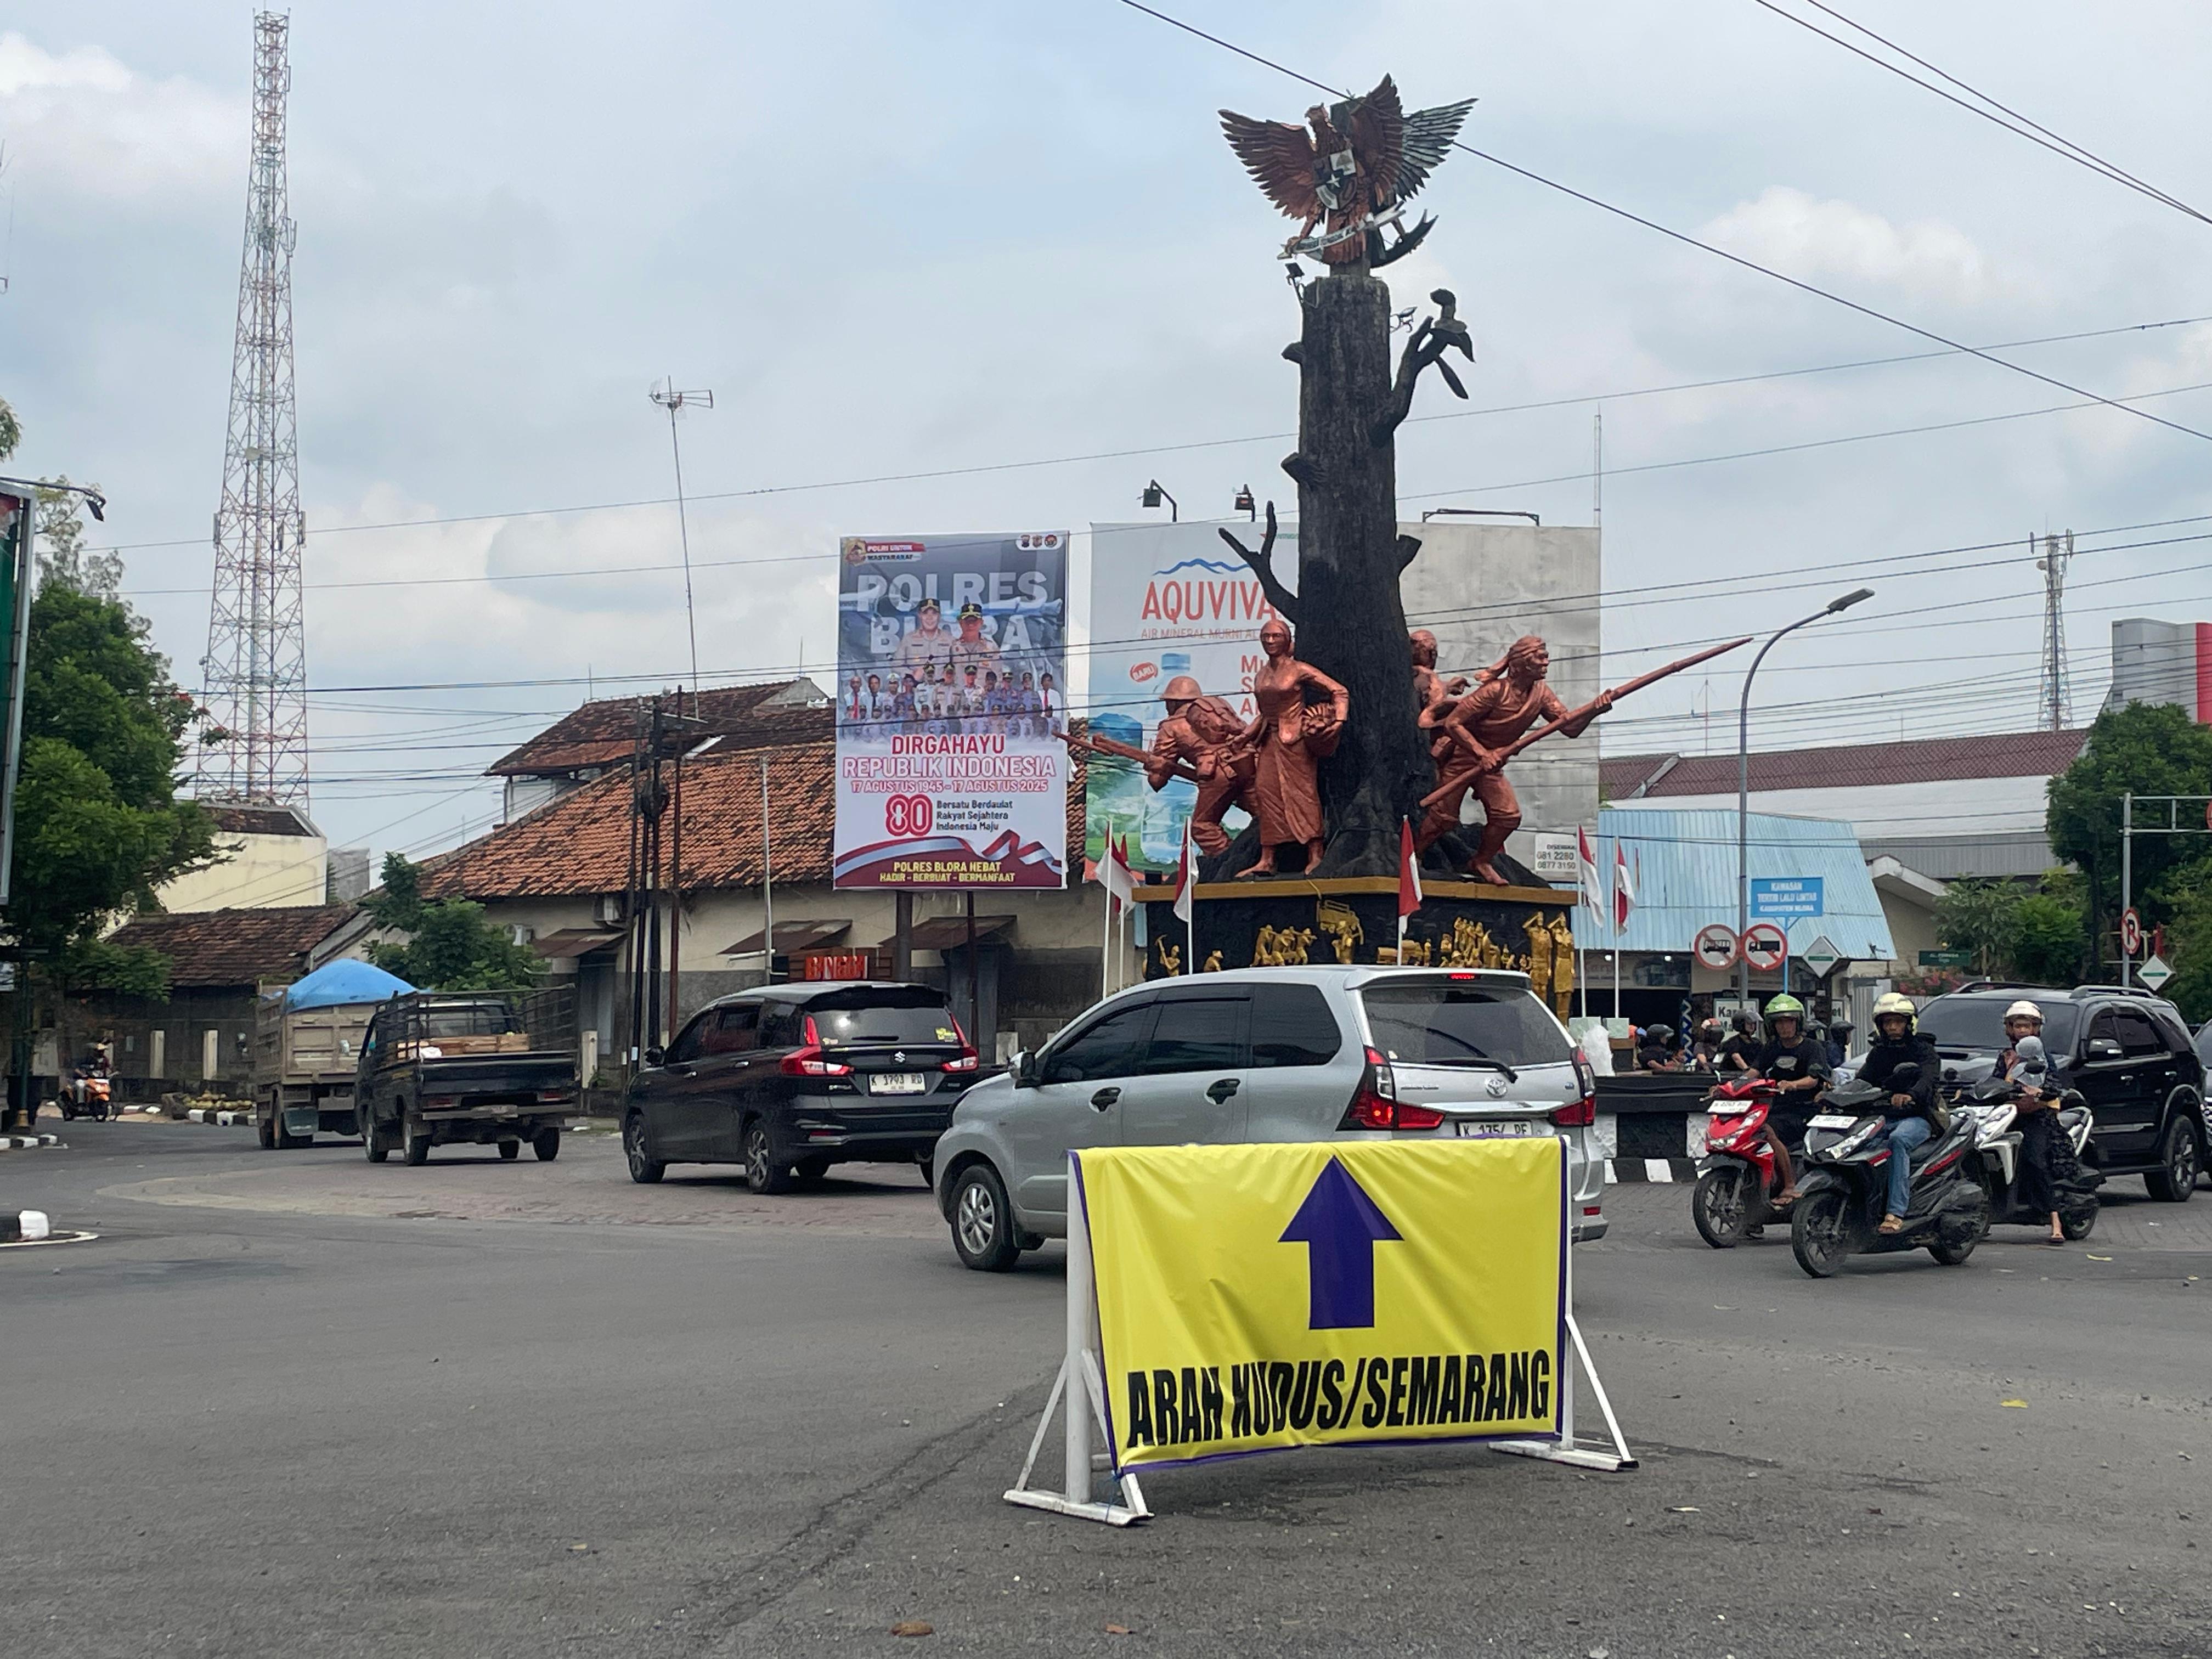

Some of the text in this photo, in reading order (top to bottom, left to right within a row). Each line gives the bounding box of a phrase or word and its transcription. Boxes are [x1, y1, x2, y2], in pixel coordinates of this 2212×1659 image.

[857, 571, 1048, 612] POLRES
[1141, 580, 1277, 624] AQUVIVA
[1141, 629, 1158, 639] AIR
[1160, 628, 1204, 639] MINERAL
[1209, 628, 1243, 639] MURNI
[891, 734, 1006, 755] DIRGAHAYU
[843, 756, 1056, 778] REPUBLIK INDONESIA
[851, 780, 863, 793] 17
[864, 780, 916, 793] AGUSTUS
[918, 780, 943, 793] 1945
[952, 780, 964, 792] 17
[966, 780, 1018, 792] AGUSTUS
[1019, 779, 1048, 792] 2025
[936, 799, 1013, 809] Bersatu Berdaulat
[885, 794, 933, 837] 80
[936, 810, 1009, 821] Rakyat Sejahtera
[936, 822, 1000, 833] Indonesia Maju
[894, 861, 1002, 872] POLRES BLORA HEBAT
[871, 1075, 877, 1086] K
[1126, 1349, 1550, 1448] ARAH KUDUS/SEMARANG
